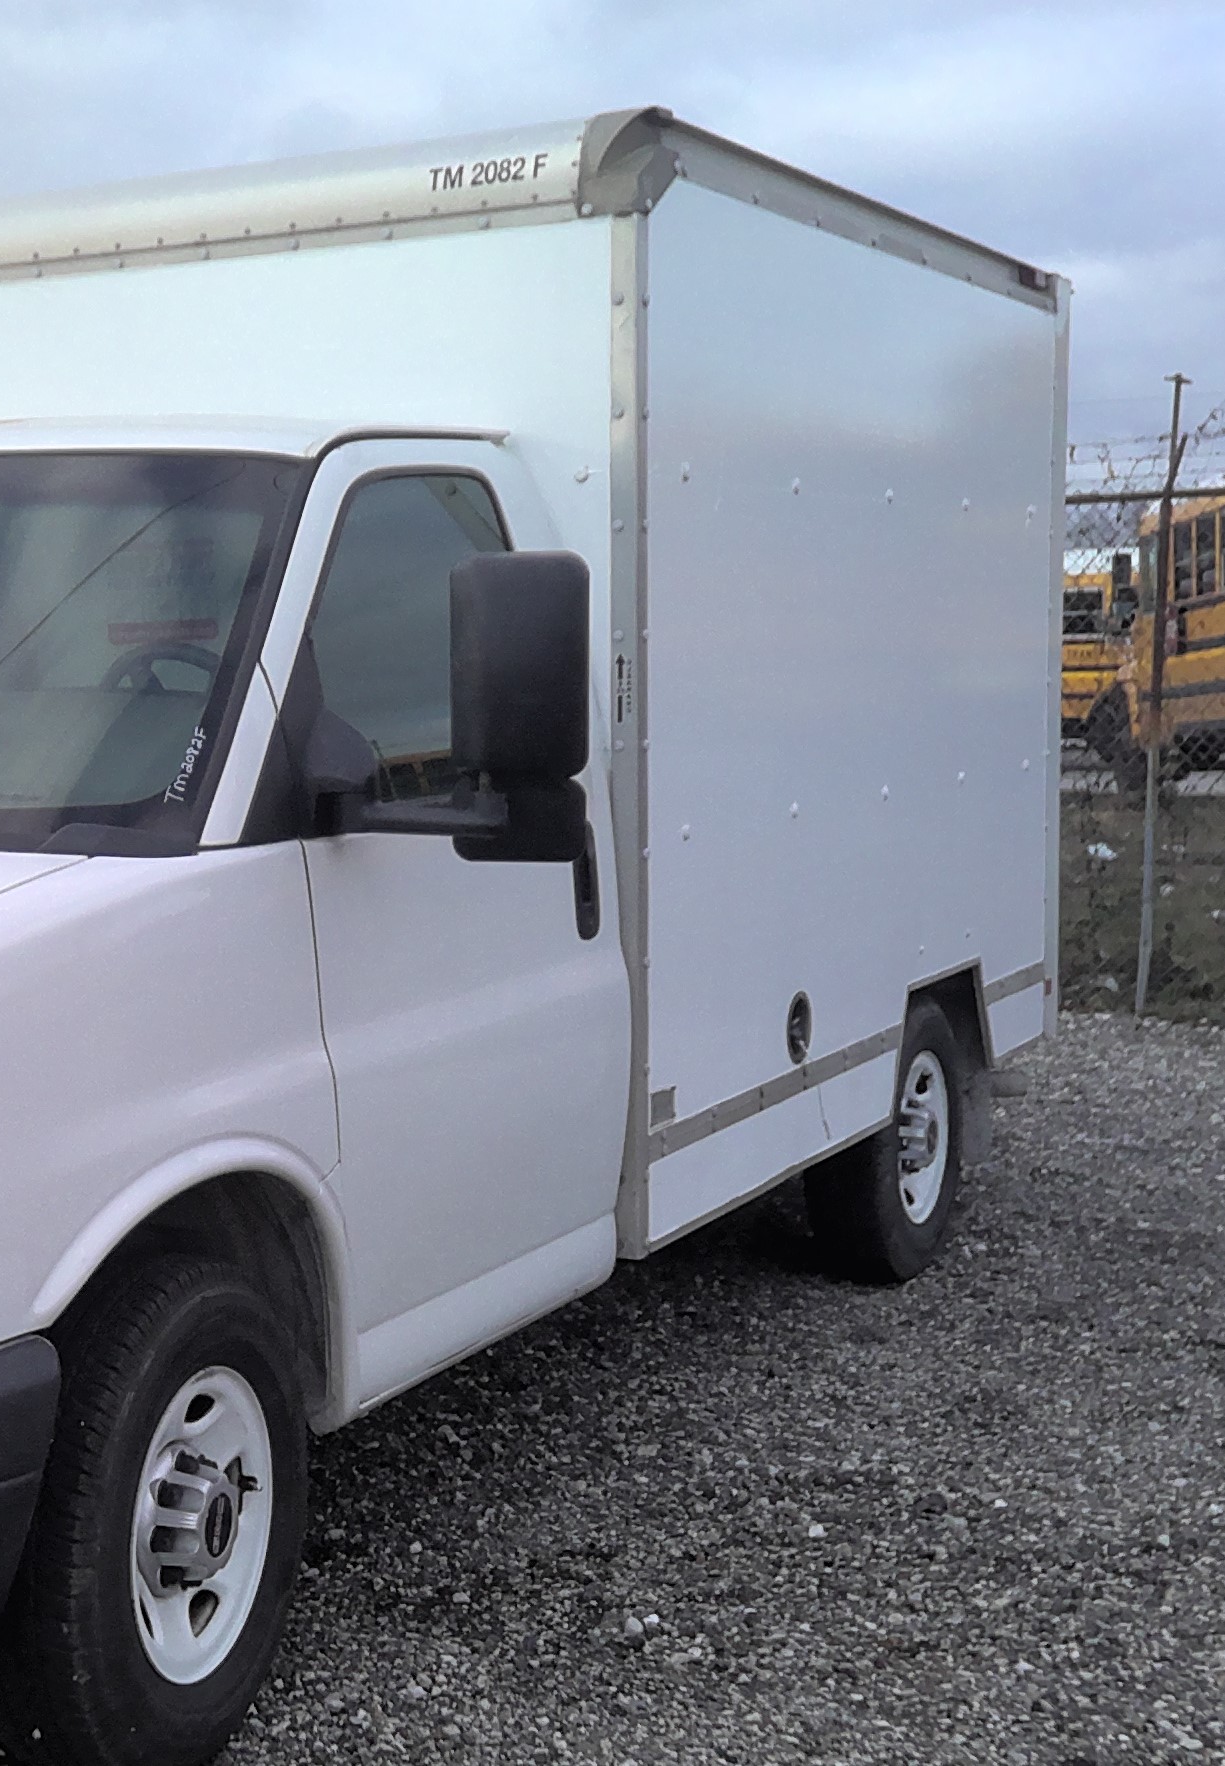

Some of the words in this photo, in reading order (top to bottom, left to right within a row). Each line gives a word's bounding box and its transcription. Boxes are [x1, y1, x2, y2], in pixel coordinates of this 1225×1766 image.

[429, 165, 464, 191] TM
[471, 157, 526, 187] 2082
[533, 153, 548, 178] F
